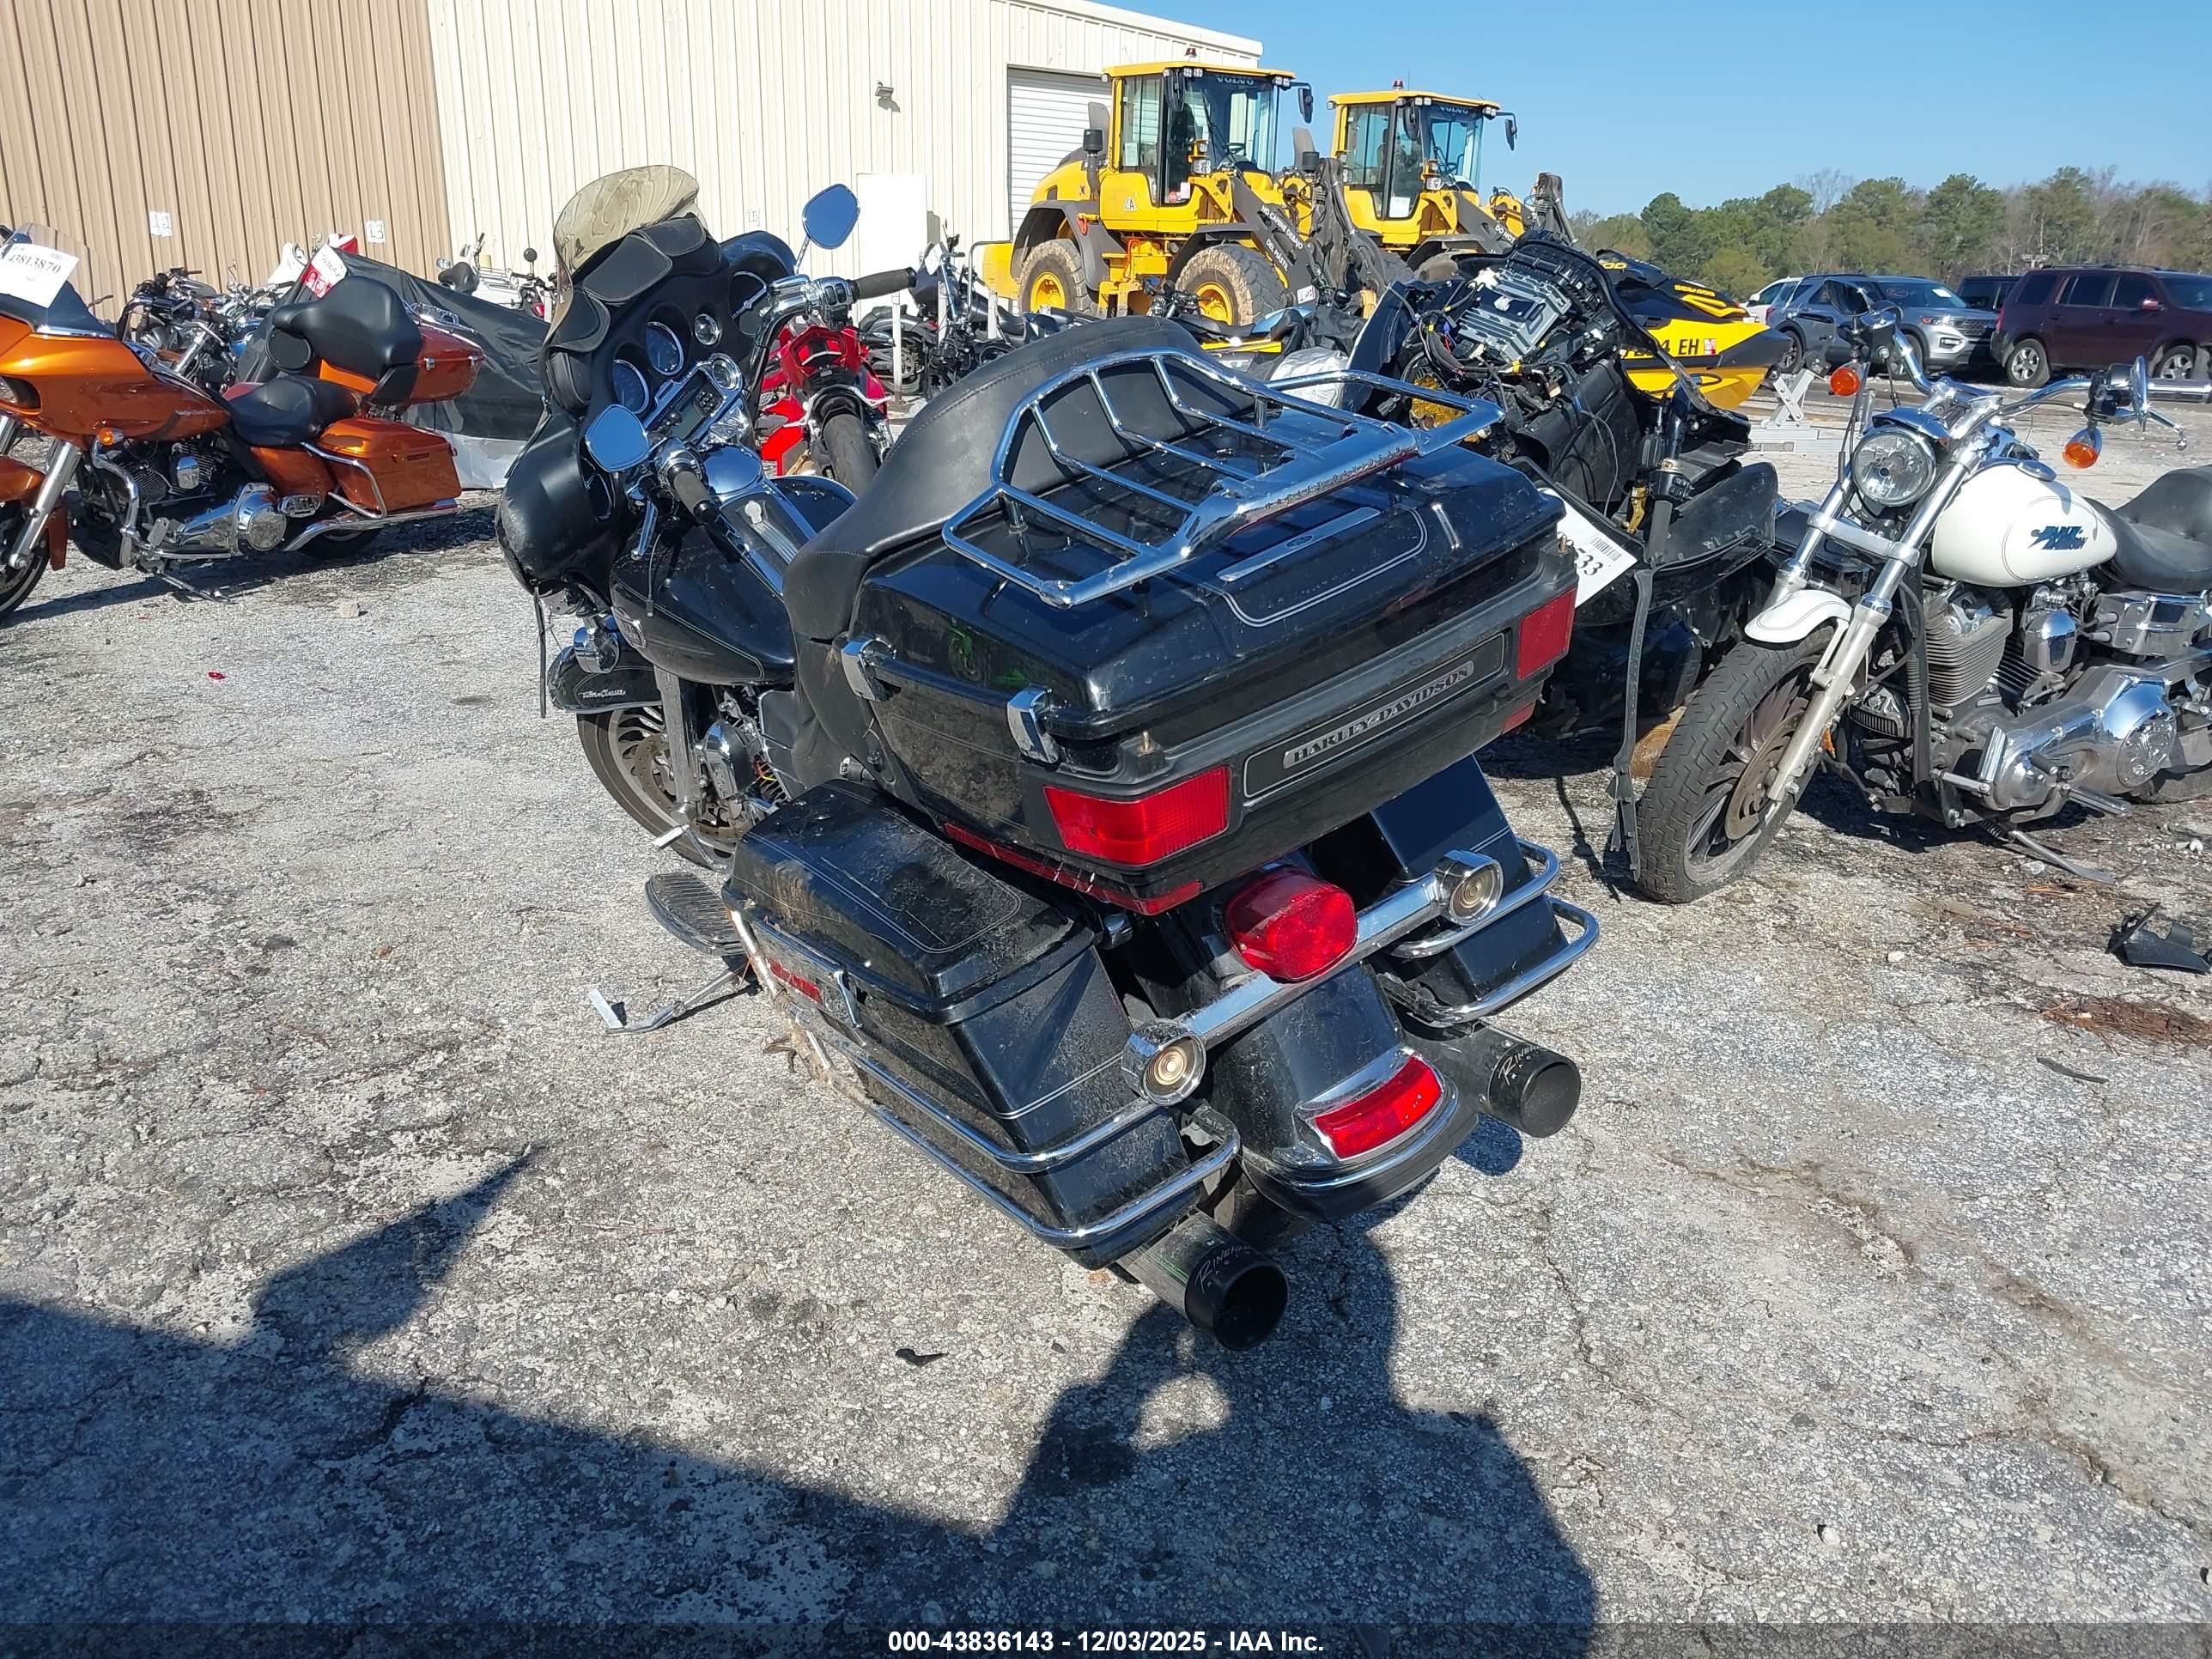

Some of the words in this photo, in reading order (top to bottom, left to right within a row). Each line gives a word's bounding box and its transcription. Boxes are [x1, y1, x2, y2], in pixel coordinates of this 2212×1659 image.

[1216, 76, 1255, 86] VOLVO
[1440, 106, 1469, 115] VOLVO
[1261, 205, 1270, 216] NO
[1285, 228, 1304, 249] DEBAJO
[1495, 224, 1504, 234] DO
[1503, 232, 1516, 244] NOT
[1266, 240, 1275, 252] DEL
[1678, 338, 1699, 356] EH
[1292, 665, 1470, 763] HARLEY-DAVIDSON
